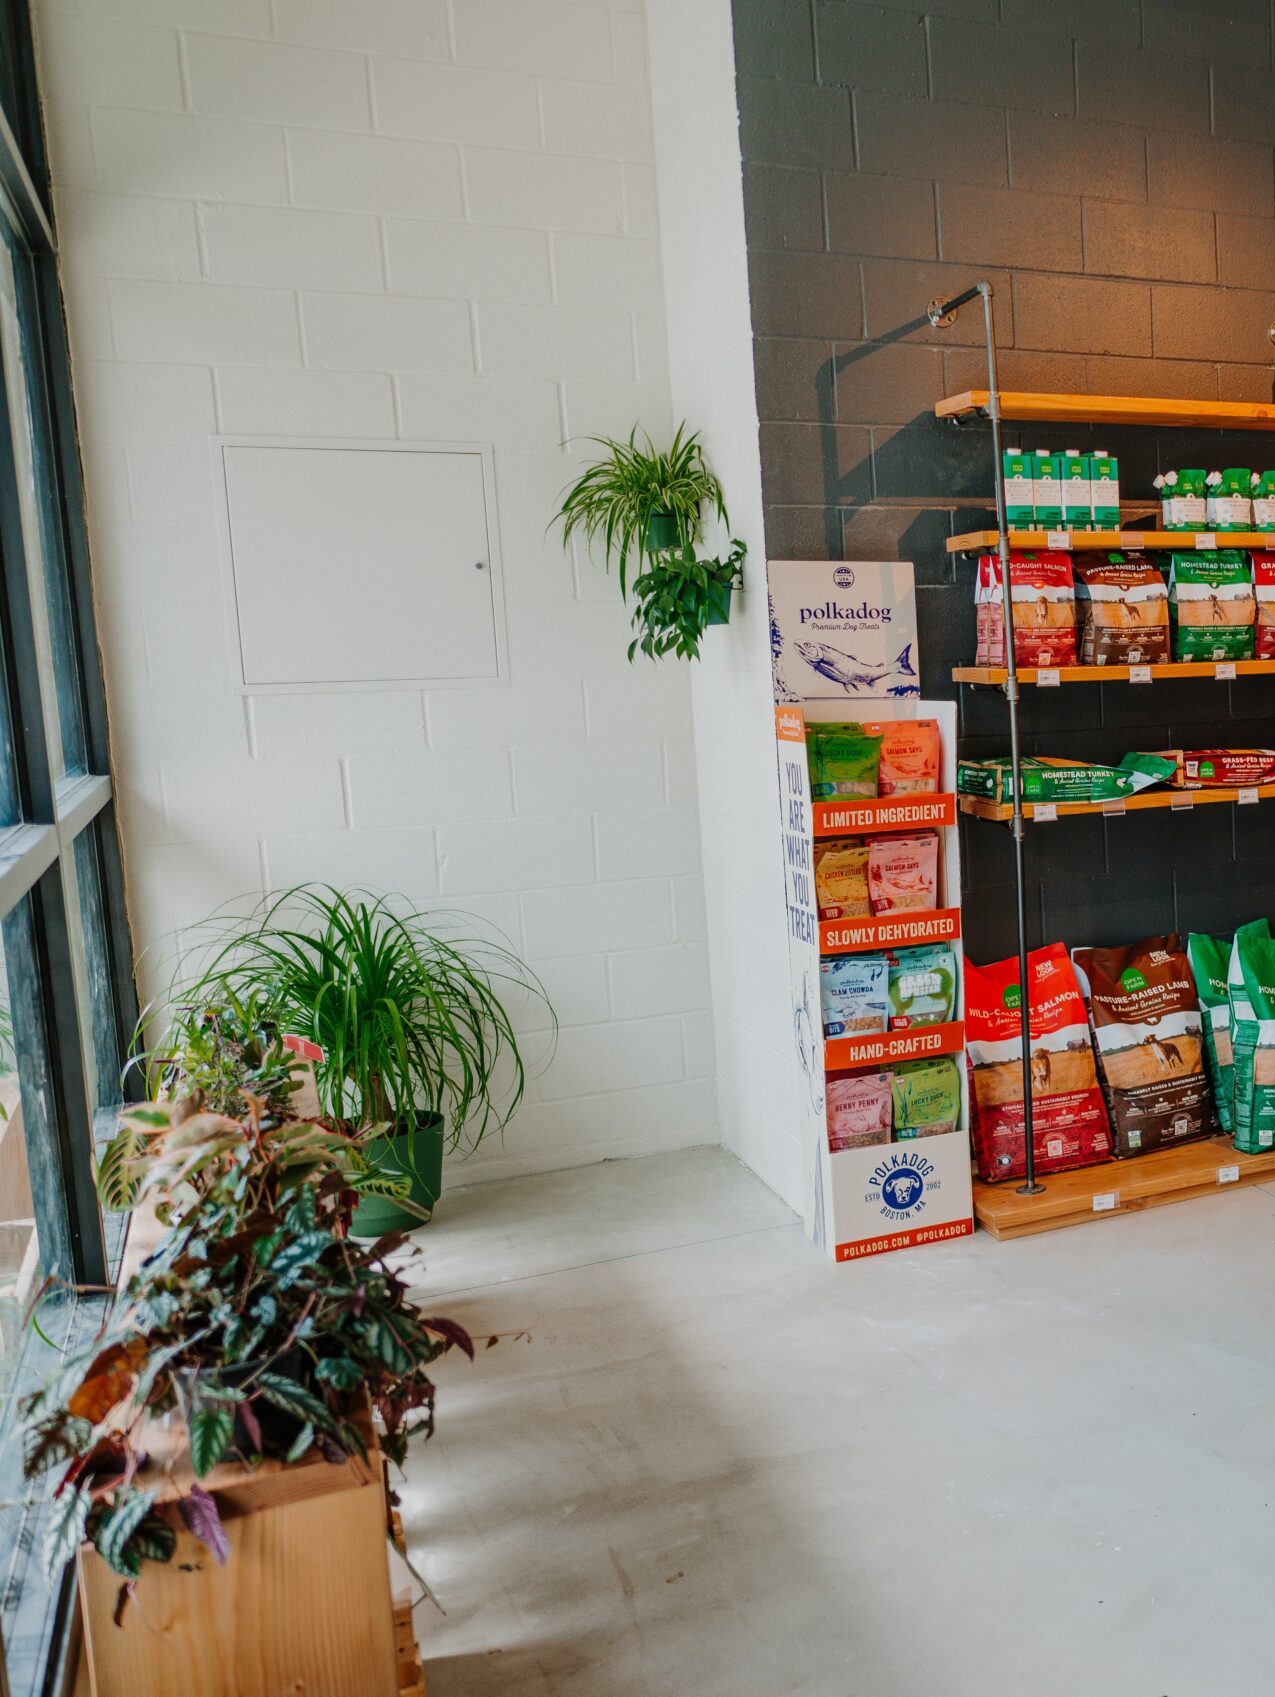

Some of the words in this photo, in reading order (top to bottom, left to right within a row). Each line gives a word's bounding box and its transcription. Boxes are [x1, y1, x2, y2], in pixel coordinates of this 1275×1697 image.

[1044, 563, 1066, 572] SALMON
[1087, 565, 1136, 576] PASTURE-RAISED
[800, 602, 892, 624] polkadog
[811, 622, 841, 630] Premium
[843, 623, 857, 632] Dog
[860, 622, 880, 630] Treats
[786, 762, 802, 796] YOU
[789, 800, 805, 833] ARE
[823, 810, 873, 828] LIMITED
[876, 804, 946, 824] INGREDIENT
[786, 834, 810, 871] WHAT
[885, 864, 906, 872] SALMON
[793, 872, 810, 908] YOU
[790, 906, 816, 946] TREAT
[827, 928, 875, 946] SLOWLY
[878, 918, 953, 941] DEHYDRATED
[1150, 951, 1166, 959] NEW
[1035, 960, 1051, 971] NEW
[1037, 966, 1054, 978] LOOK
[1124, 976, 1142, 985] OPEN
[1126, 982, 1144, 990] FARM
[849, 986, 874, 994] CHOWDA
[1094, 985, 1164, 1004] PASTURE-RAISED
[1168, 980, 1189, 992] LAMB
[1037, 992, 1079, 1012] SALMON
[1044, 1008, 1062, 1019] Recipe
[850, 1035, 941, 1061] HAND-CRAFTED
[835, 1102, 856, 1112] HENNY
[858, 1098, 879, 1107] PENNY
[869, 1152, 934, 1186] POLKADOG
[926, 1182, 941, 1190] 2002
[865, 1194, 880, 1202] ESTD
[915, 1200, 927, 1213] MA
[844, 1236, 910, 1257] POLKADOG.COM
[917, 1225, 966, 1242] @POLKADOG
